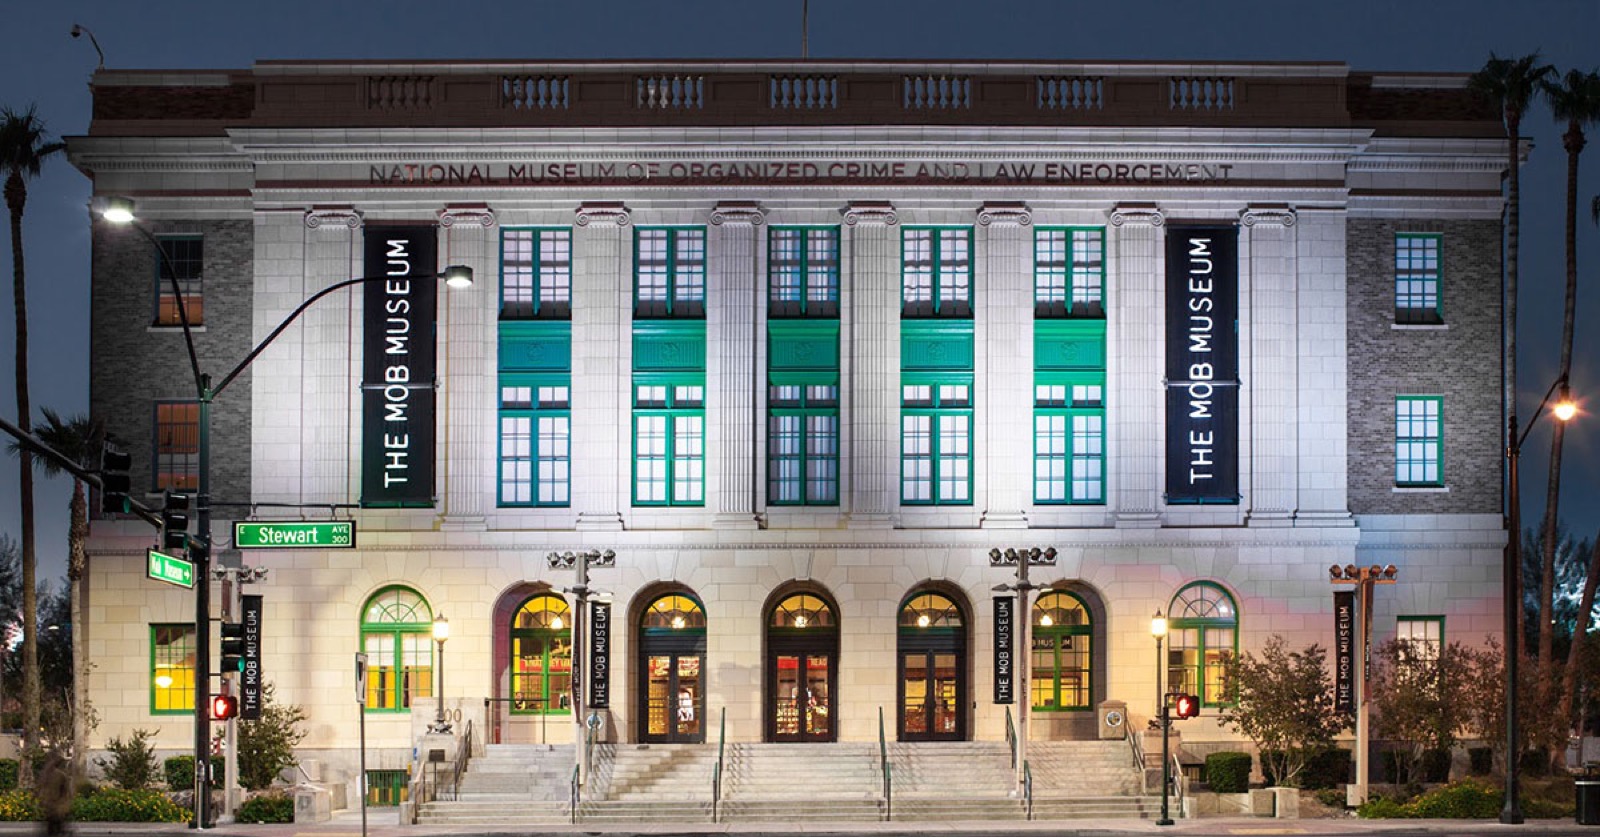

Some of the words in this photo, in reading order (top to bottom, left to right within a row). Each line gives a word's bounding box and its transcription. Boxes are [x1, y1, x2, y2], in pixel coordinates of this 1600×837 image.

[370, 163, 499, 184] NATIONAL
[508, 163, 616, 183] MUSEUM
[626, 162, 660, 182] OF
[669, 162, 818, 182] ORGANIZED
[828, 162, 905, 182] CRIME
[916, 162, 969, 182] AND
[979, 162, 1035, 182] LAW
[1045, 163, 1233, 182] ENFORCEMENT
[386, 239, 410, 354] MUSEUM
[1189, 238, 1213, 352] MUSEUM
[384, 364, 409, 421] MOB
[1189, 363, 1213, 418] MOB
[384, 433, 409, 488] THE
[1189, 430, 1213, 484] THE
[259, 527, 318, 543] Stewart
[247, 610, 257, 657] MUSEUM
[595, 606, 606, 652] MUSEUM
[999, 602, 1008, 648] MUSEUM
[1340, 606, 1349, 653] MUSEUM
[246, 660, 257, 685] MOB
[595, 655, 606, 680] MOB
[999, 651, 1009, 674] MOB
[1340, 657, 1349, 680] MOB
[245, 687, 256, 711] THE
[595, 683, 606, 704] THE
[999, 677, 1009, 700] THE
[1340, 683, 1349, 704] THE
